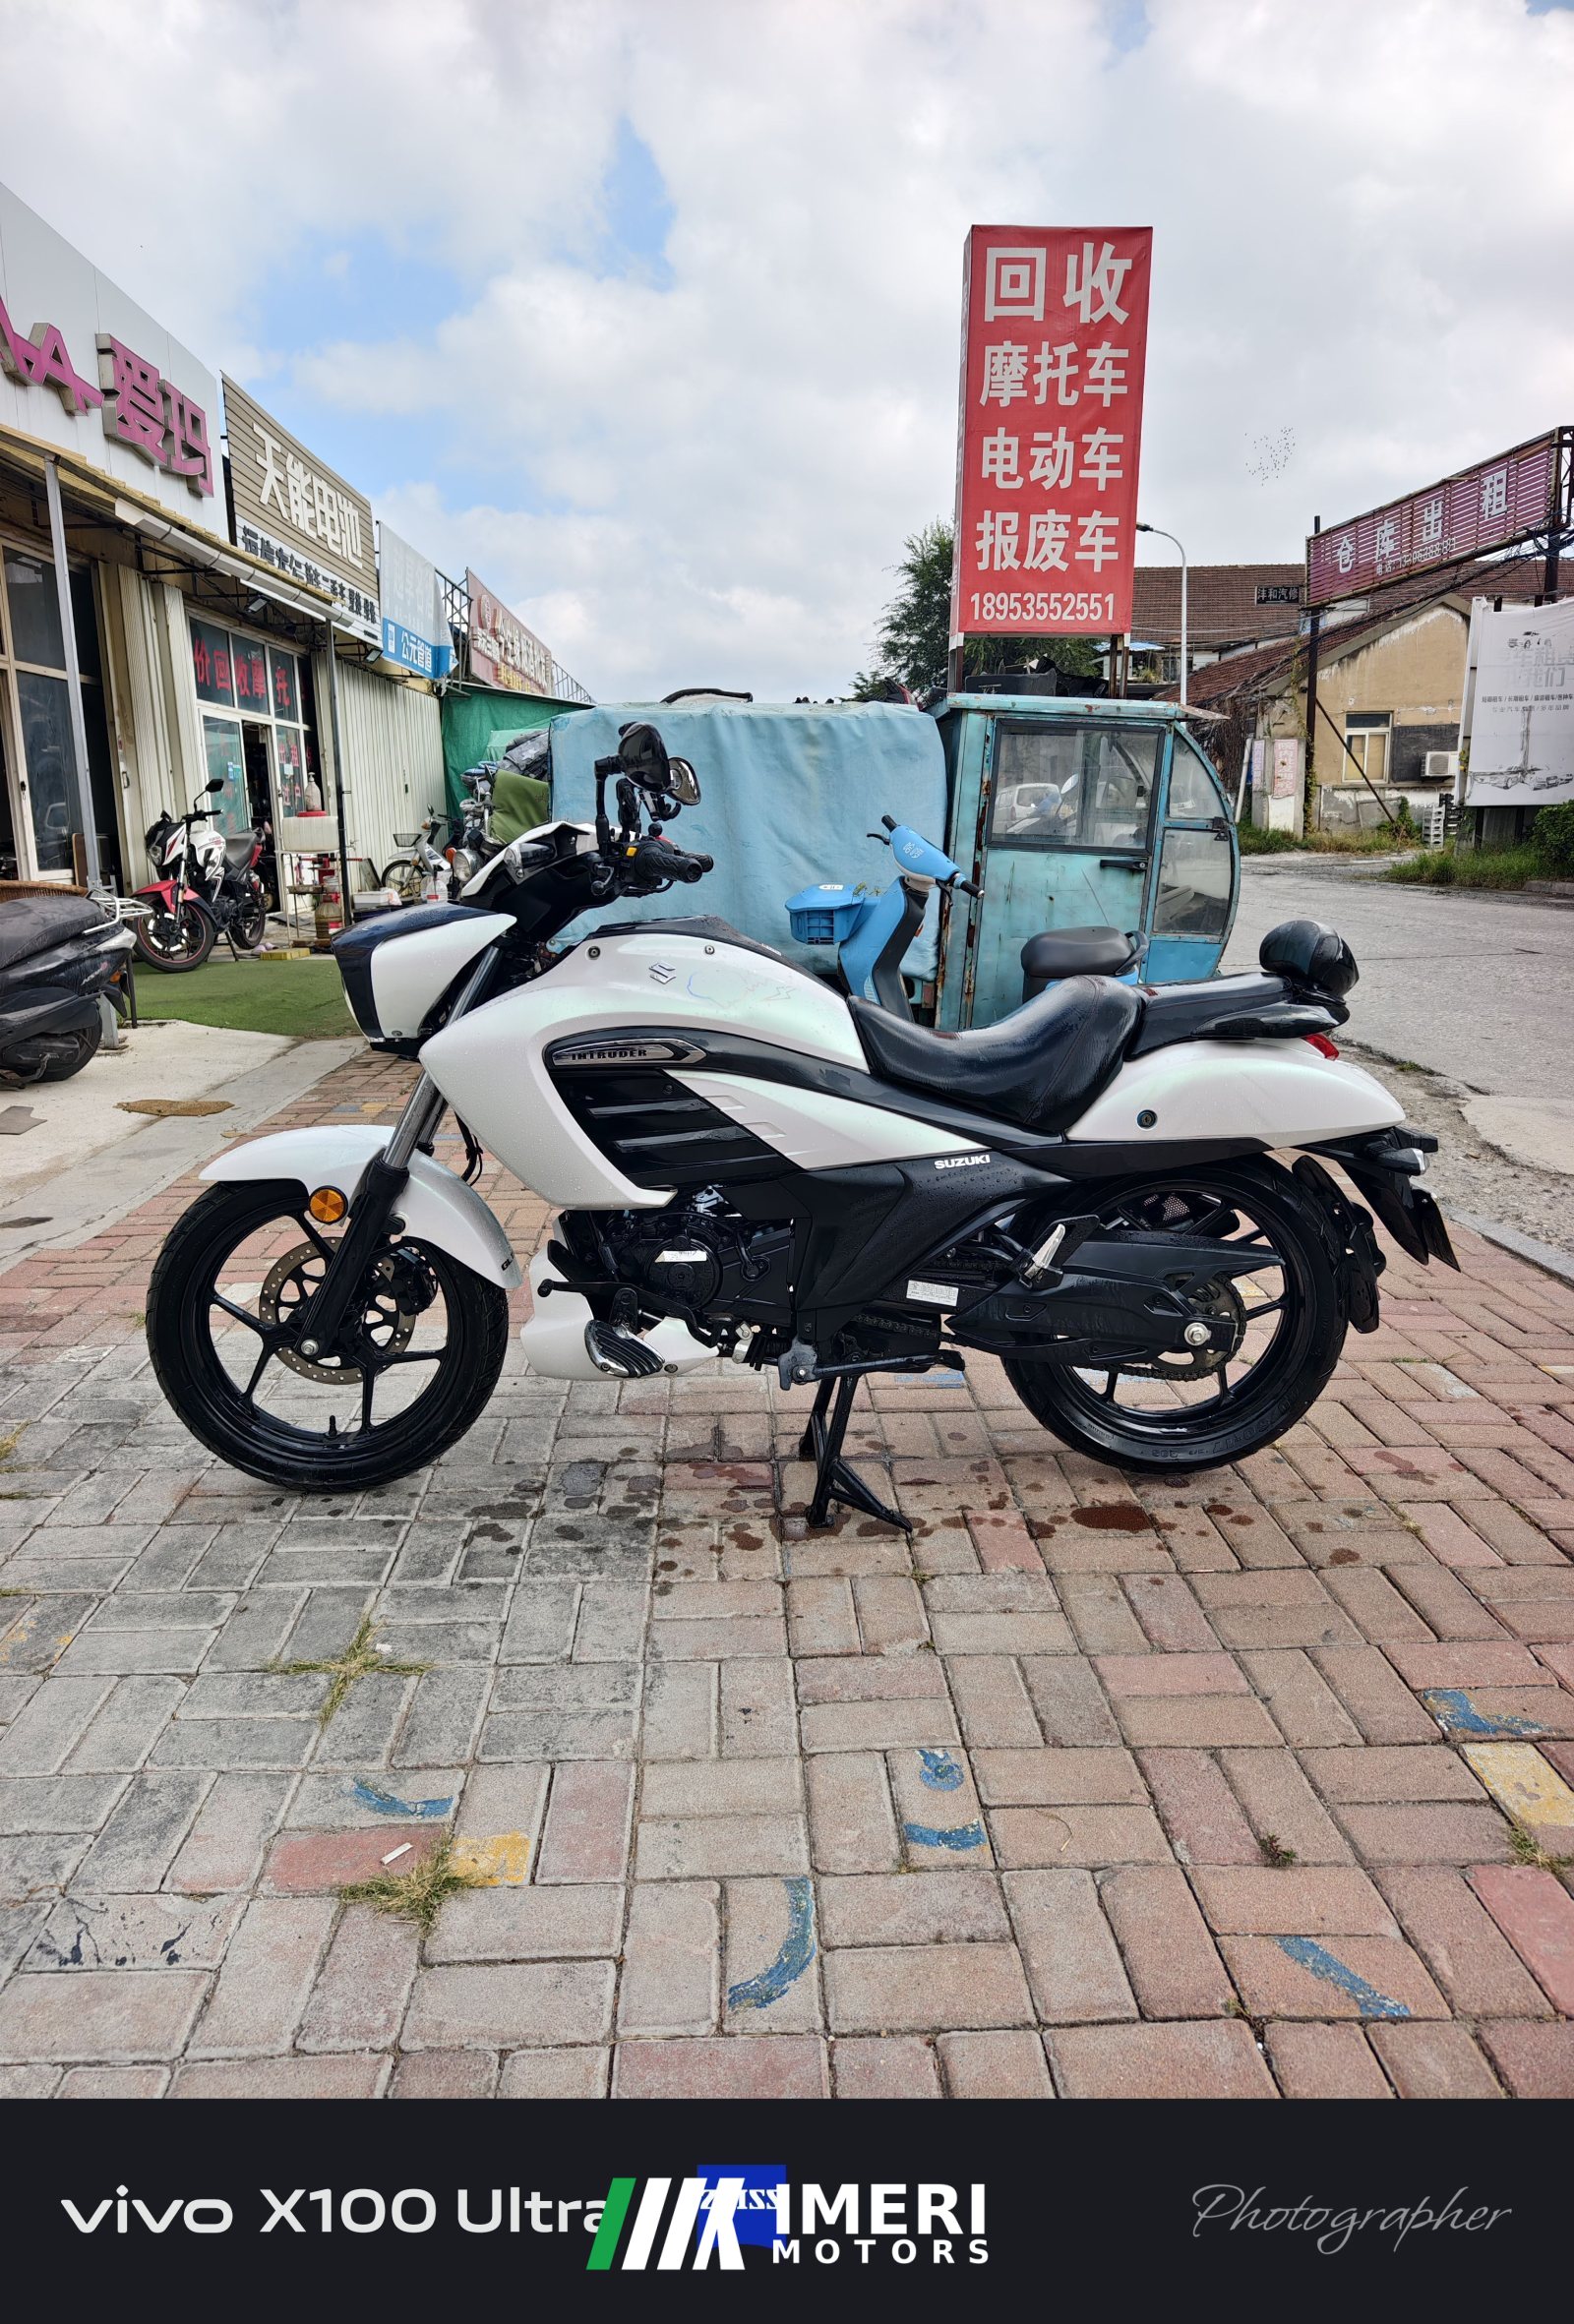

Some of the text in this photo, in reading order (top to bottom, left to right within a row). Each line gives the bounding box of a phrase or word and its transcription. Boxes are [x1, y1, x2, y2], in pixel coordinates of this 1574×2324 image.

[984, 242, 1132, 326] 回收
[980, 339, 1129, 408] 摩托车
[96, 332, 214, 499] 爱玛
[981, 426, 1124, 492] 电动车
[253, 422, 364, 570] 天能电池
[1337, 469, 1508, 574] 仓库出租
[975, 508, 1120, 572] 报废车
[970, 591, 1115, 622] 18953552551
[571, 1048, 647, 1061] INTRUDER
[934, 1154, 991, 1170] SUZUKI
